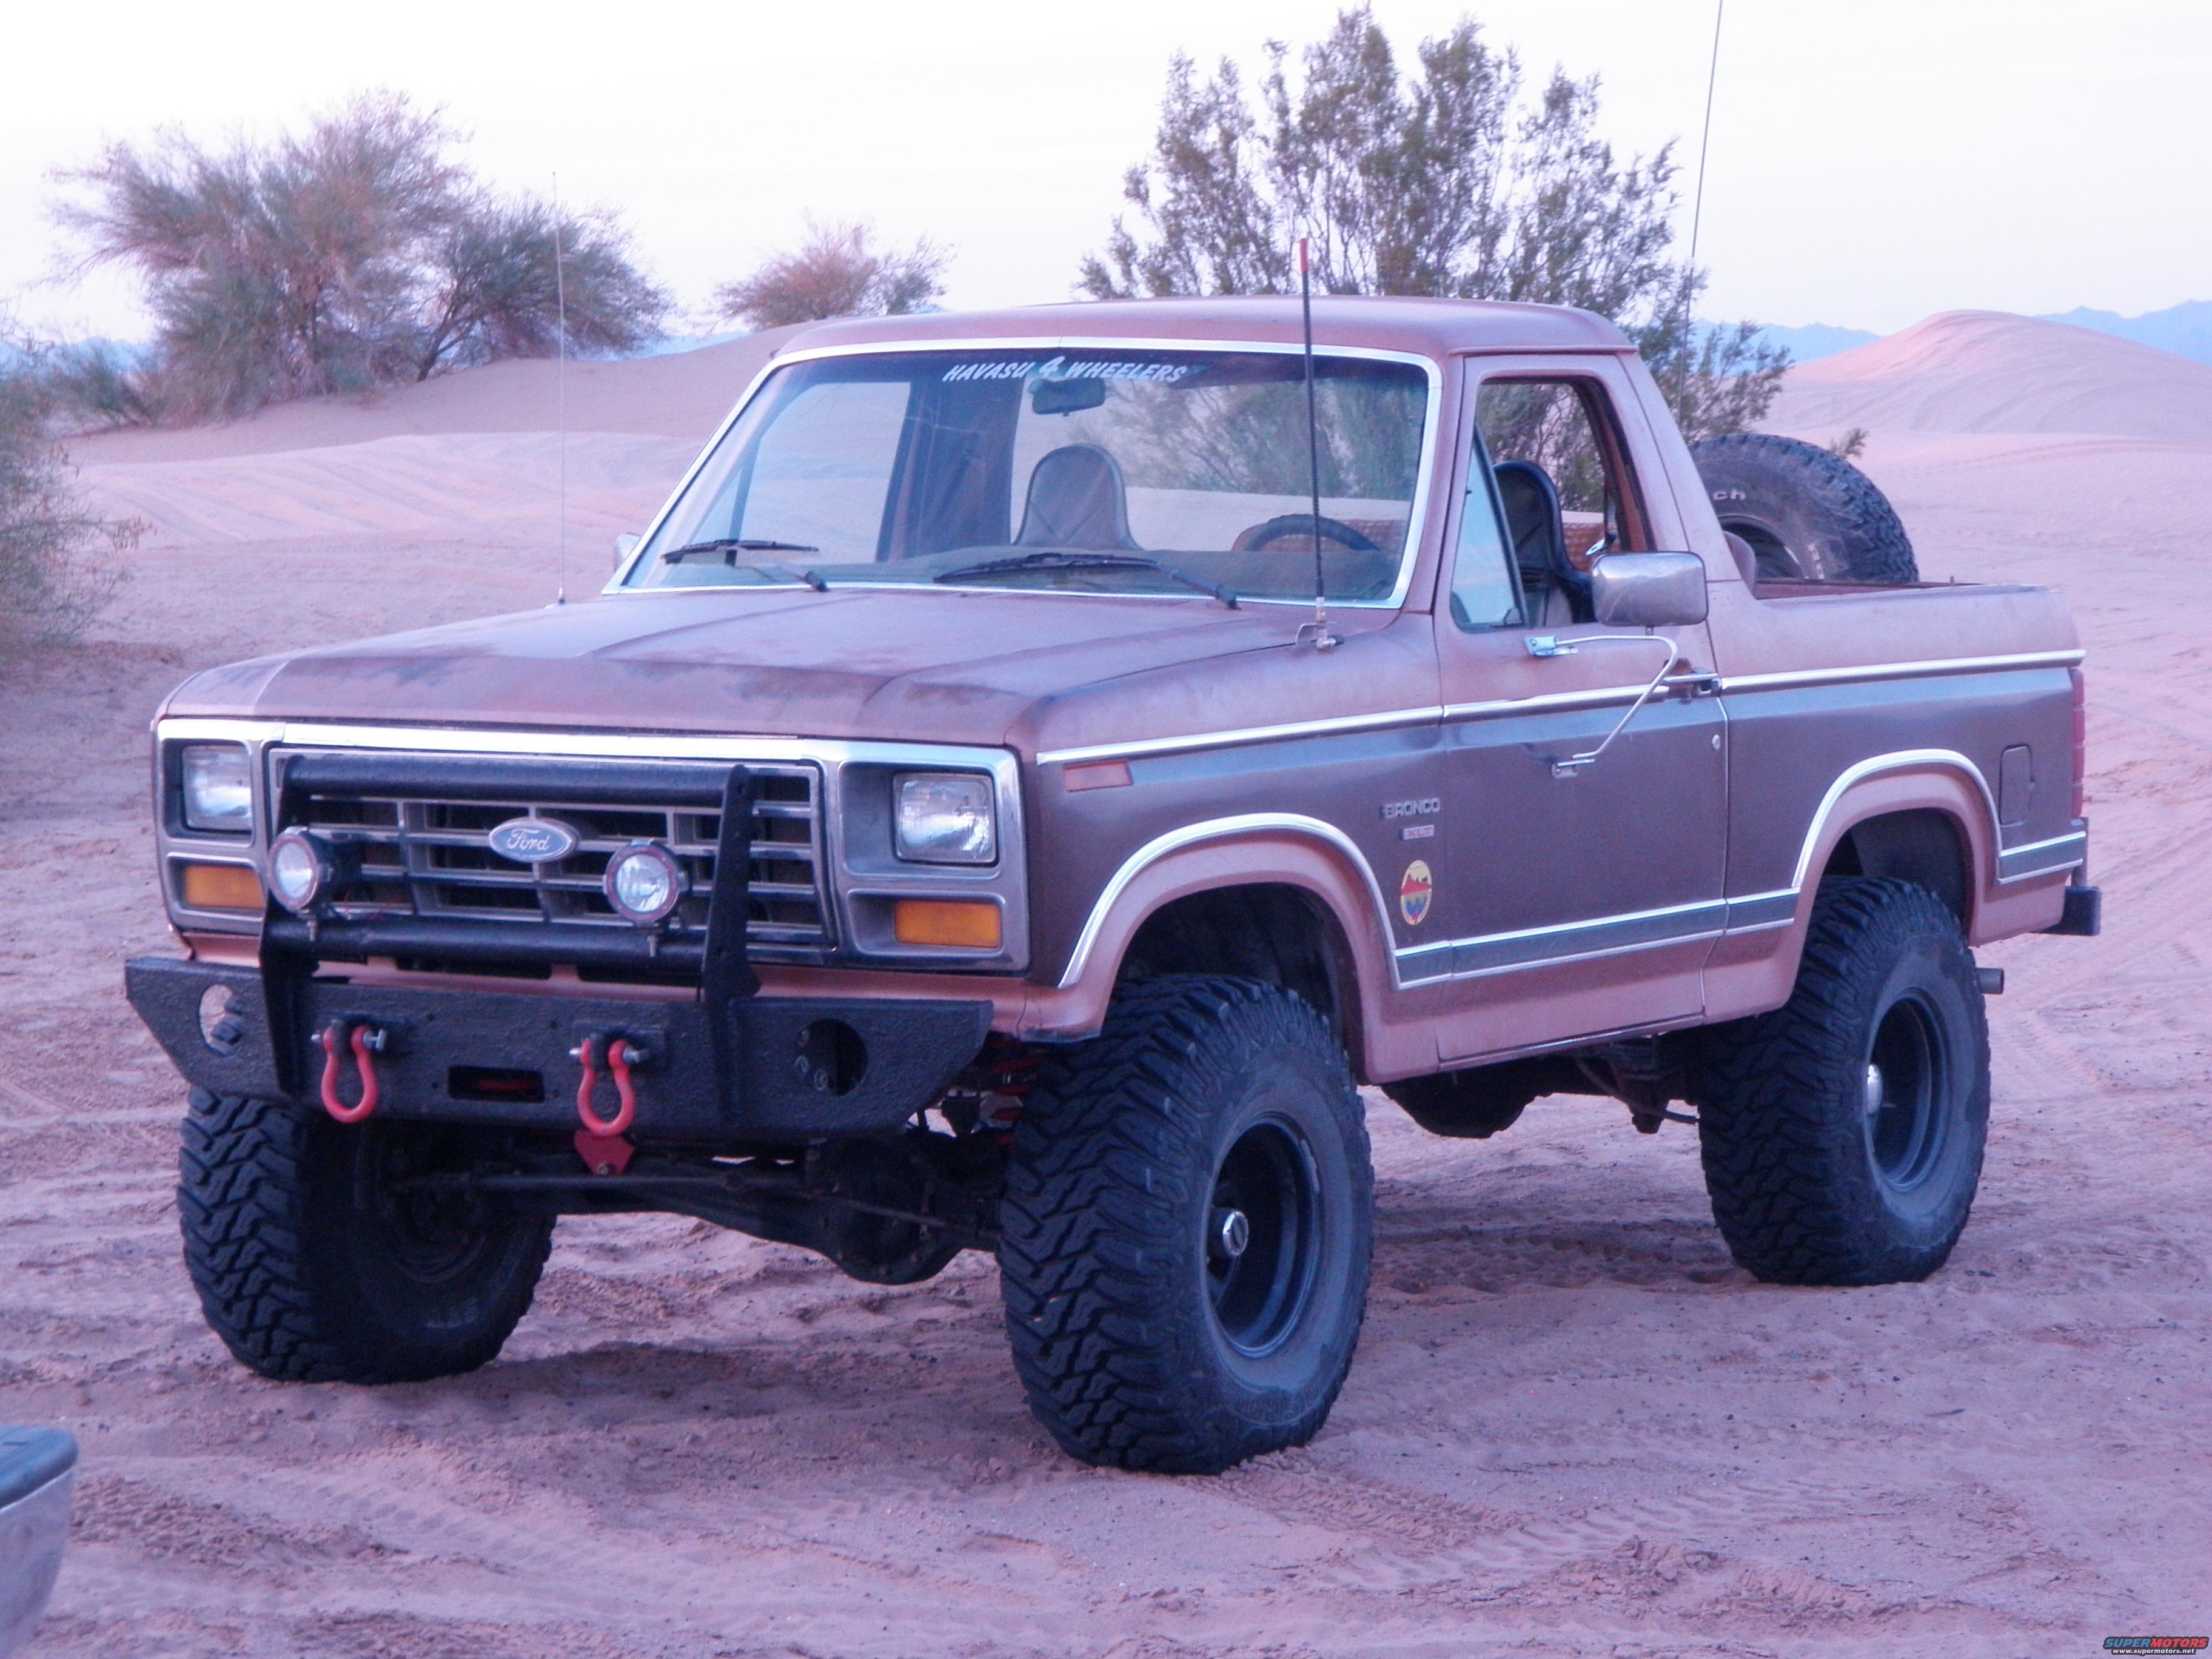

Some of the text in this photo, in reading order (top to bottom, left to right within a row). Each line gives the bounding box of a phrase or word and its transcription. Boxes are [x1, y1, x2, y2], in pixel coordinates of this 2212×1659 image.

[942, 355, 1187, 383] HAVASU 4 WHEELERS
[1384, 797, 1440, 819] BRONCO
[506, 828, 551, 851] Ford
